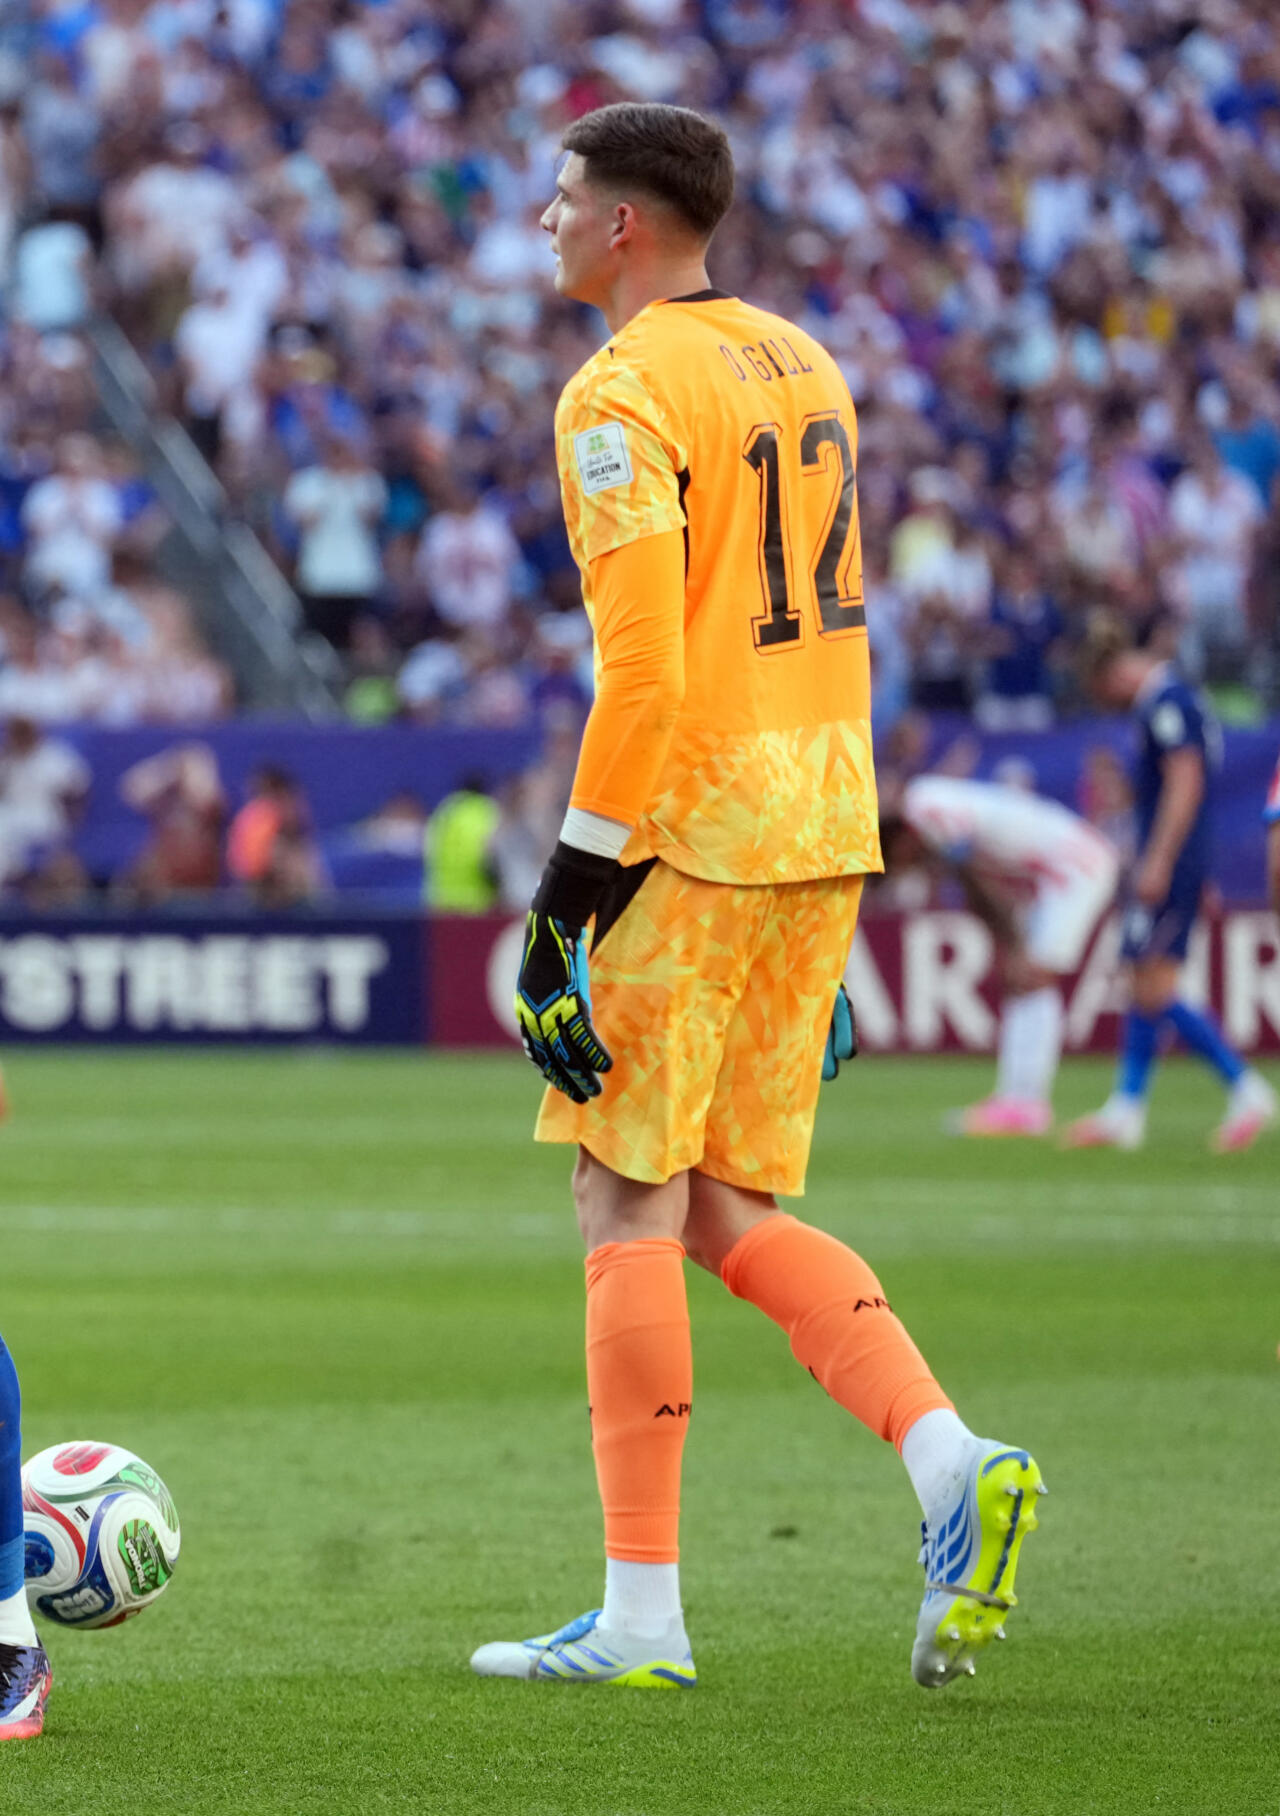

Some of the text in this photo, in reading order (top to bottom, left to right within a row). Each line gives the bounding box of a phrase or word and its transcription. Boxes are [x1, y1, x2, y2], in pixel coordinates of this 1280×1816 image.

[741, 337, 813, 382] GILL
[742, 410, 867, 656] 12
[853, 1297, 893, 1313] AP
[654, 1402, 693, 1418] AP
[124, 1538, 147, 1589] TRIONDA
